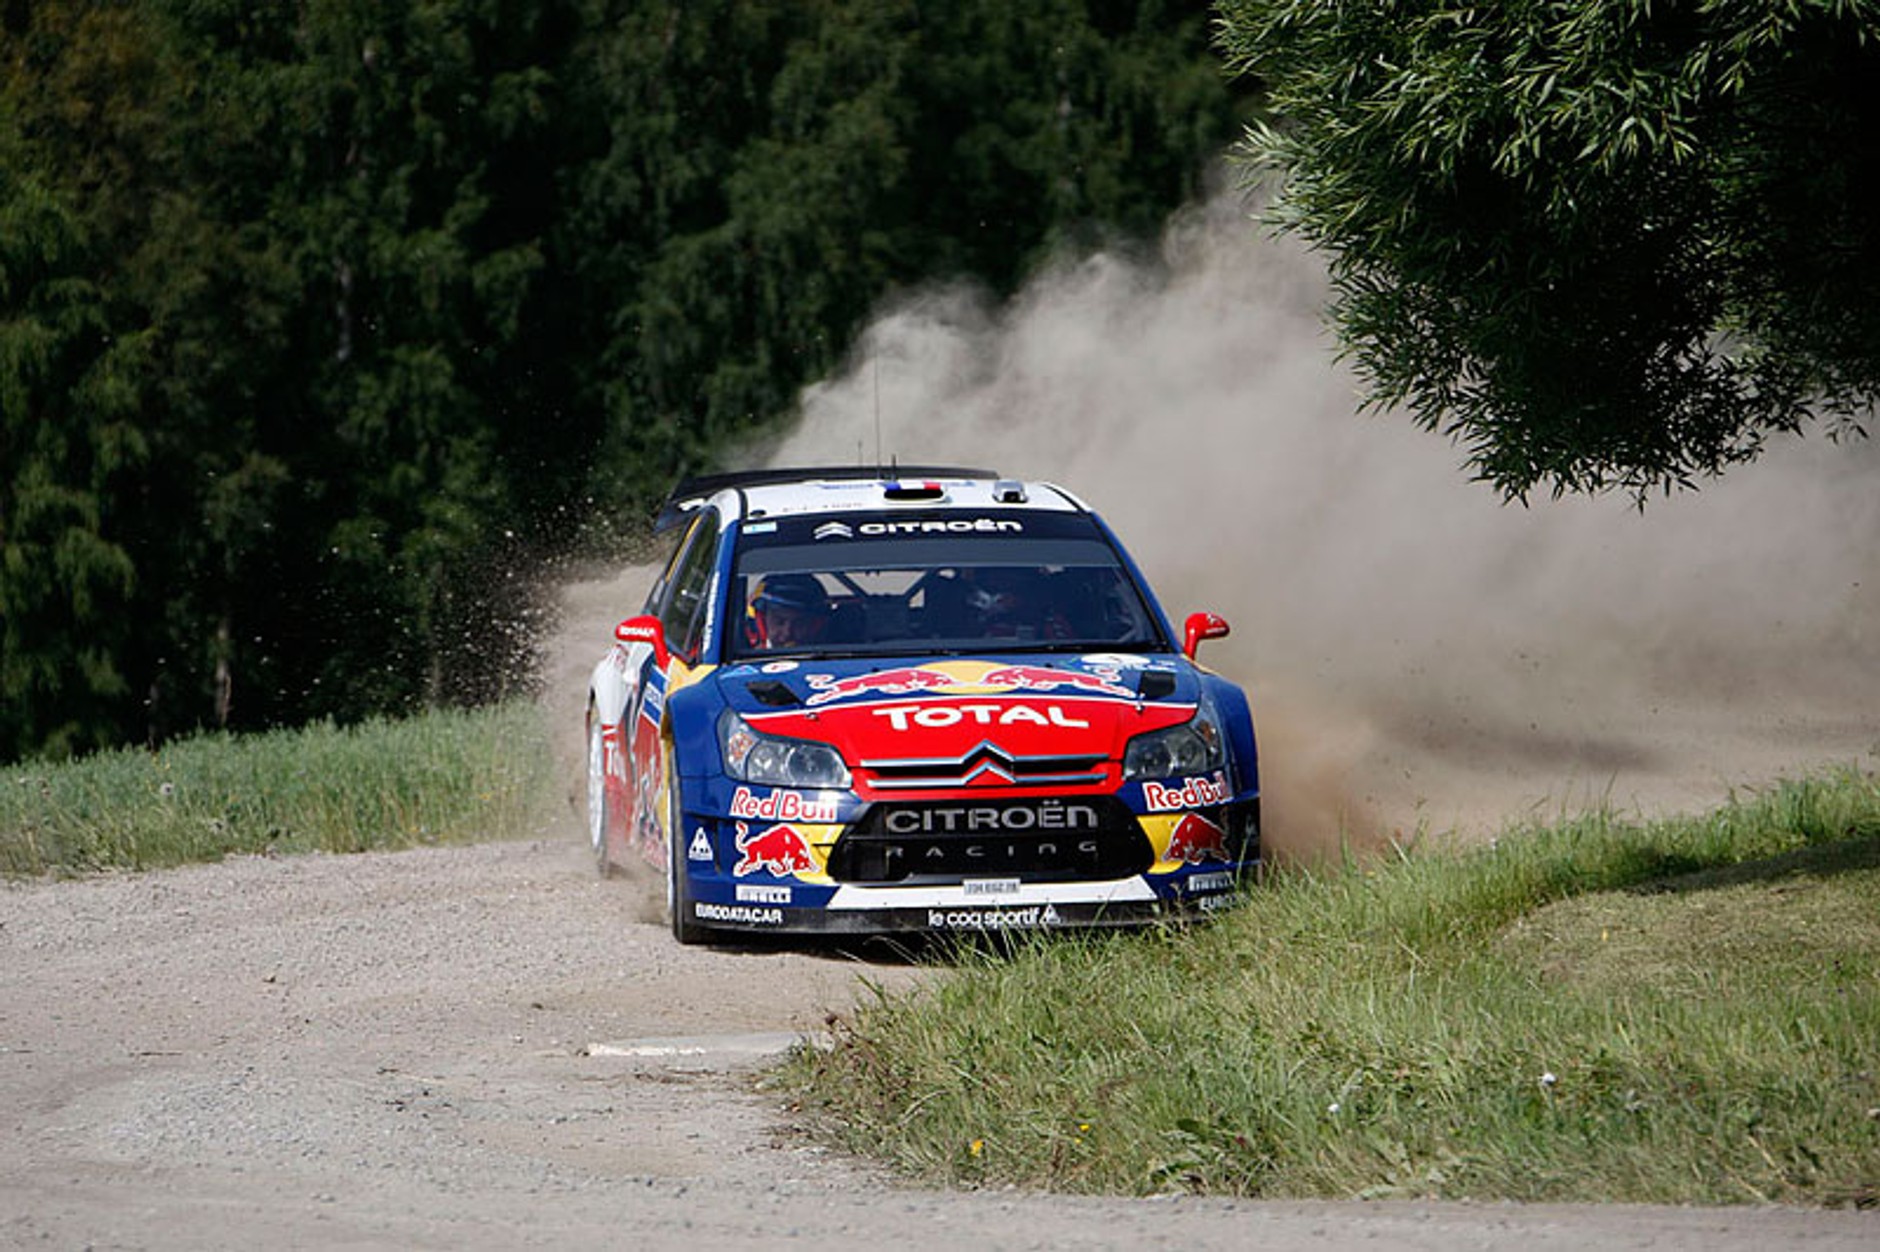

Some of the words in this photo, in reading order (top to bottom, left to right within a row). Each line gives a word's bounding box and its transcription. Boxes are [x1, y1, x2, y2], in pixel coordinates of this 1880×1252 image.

[859, 519, 1023, 535] CITROËN
[872, 705, 1090, 730] TOTAL
[731, 786, 780, 817] Red
[780, 790, 838, 820] Bull
[1143, 778, 1197, 811] Red
[886, 800, 1098, 832] CITROËN
[886, 841, 1097, 858] RACING
[928, 910, 944, 926] le
[947, 911, 982, 929] coq
[984, 907, 1039, 929] sportif
